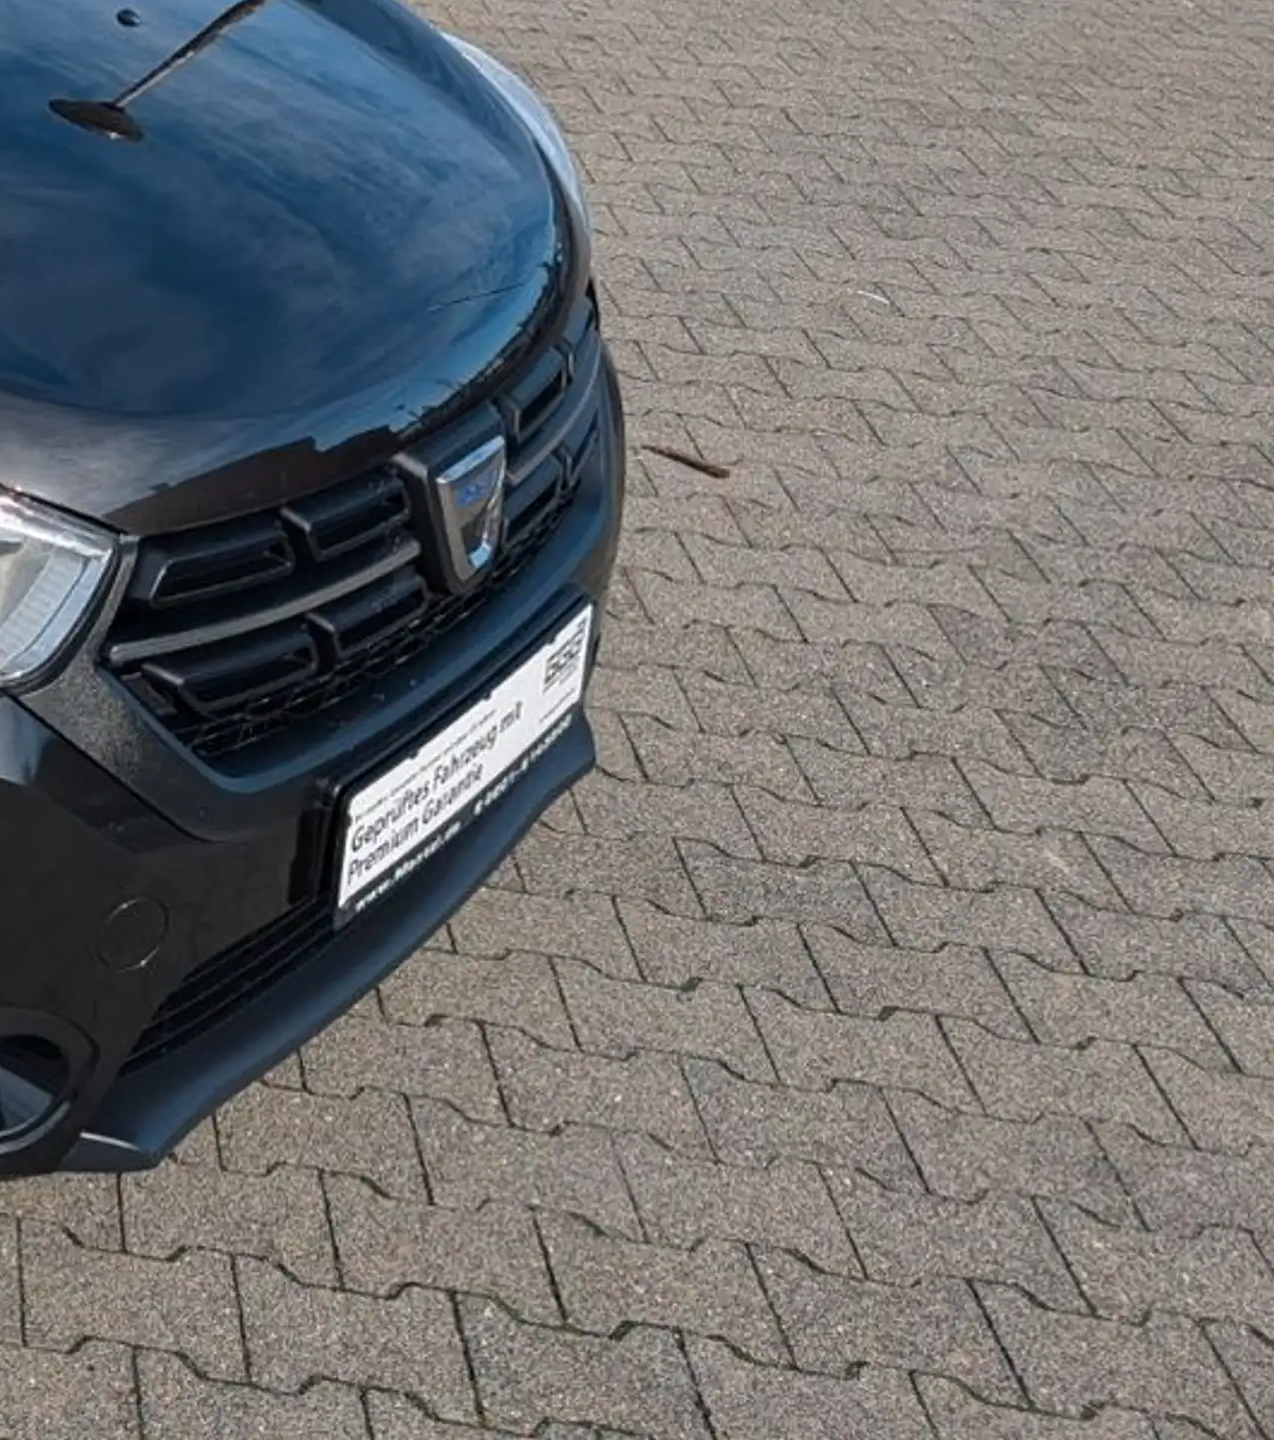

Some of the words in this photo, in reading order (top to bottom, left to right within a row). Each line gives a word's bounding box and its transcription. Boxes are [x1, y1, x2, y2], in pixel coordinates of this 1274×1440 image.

[348, 817, 419, 886] Premium
[421, 763, 485, 825] Garantie
[351, 786, 431, 852] Geprüftes
[434, 728, 499, 789] Fahrzeug
[500, 700, 524, 734] mit
